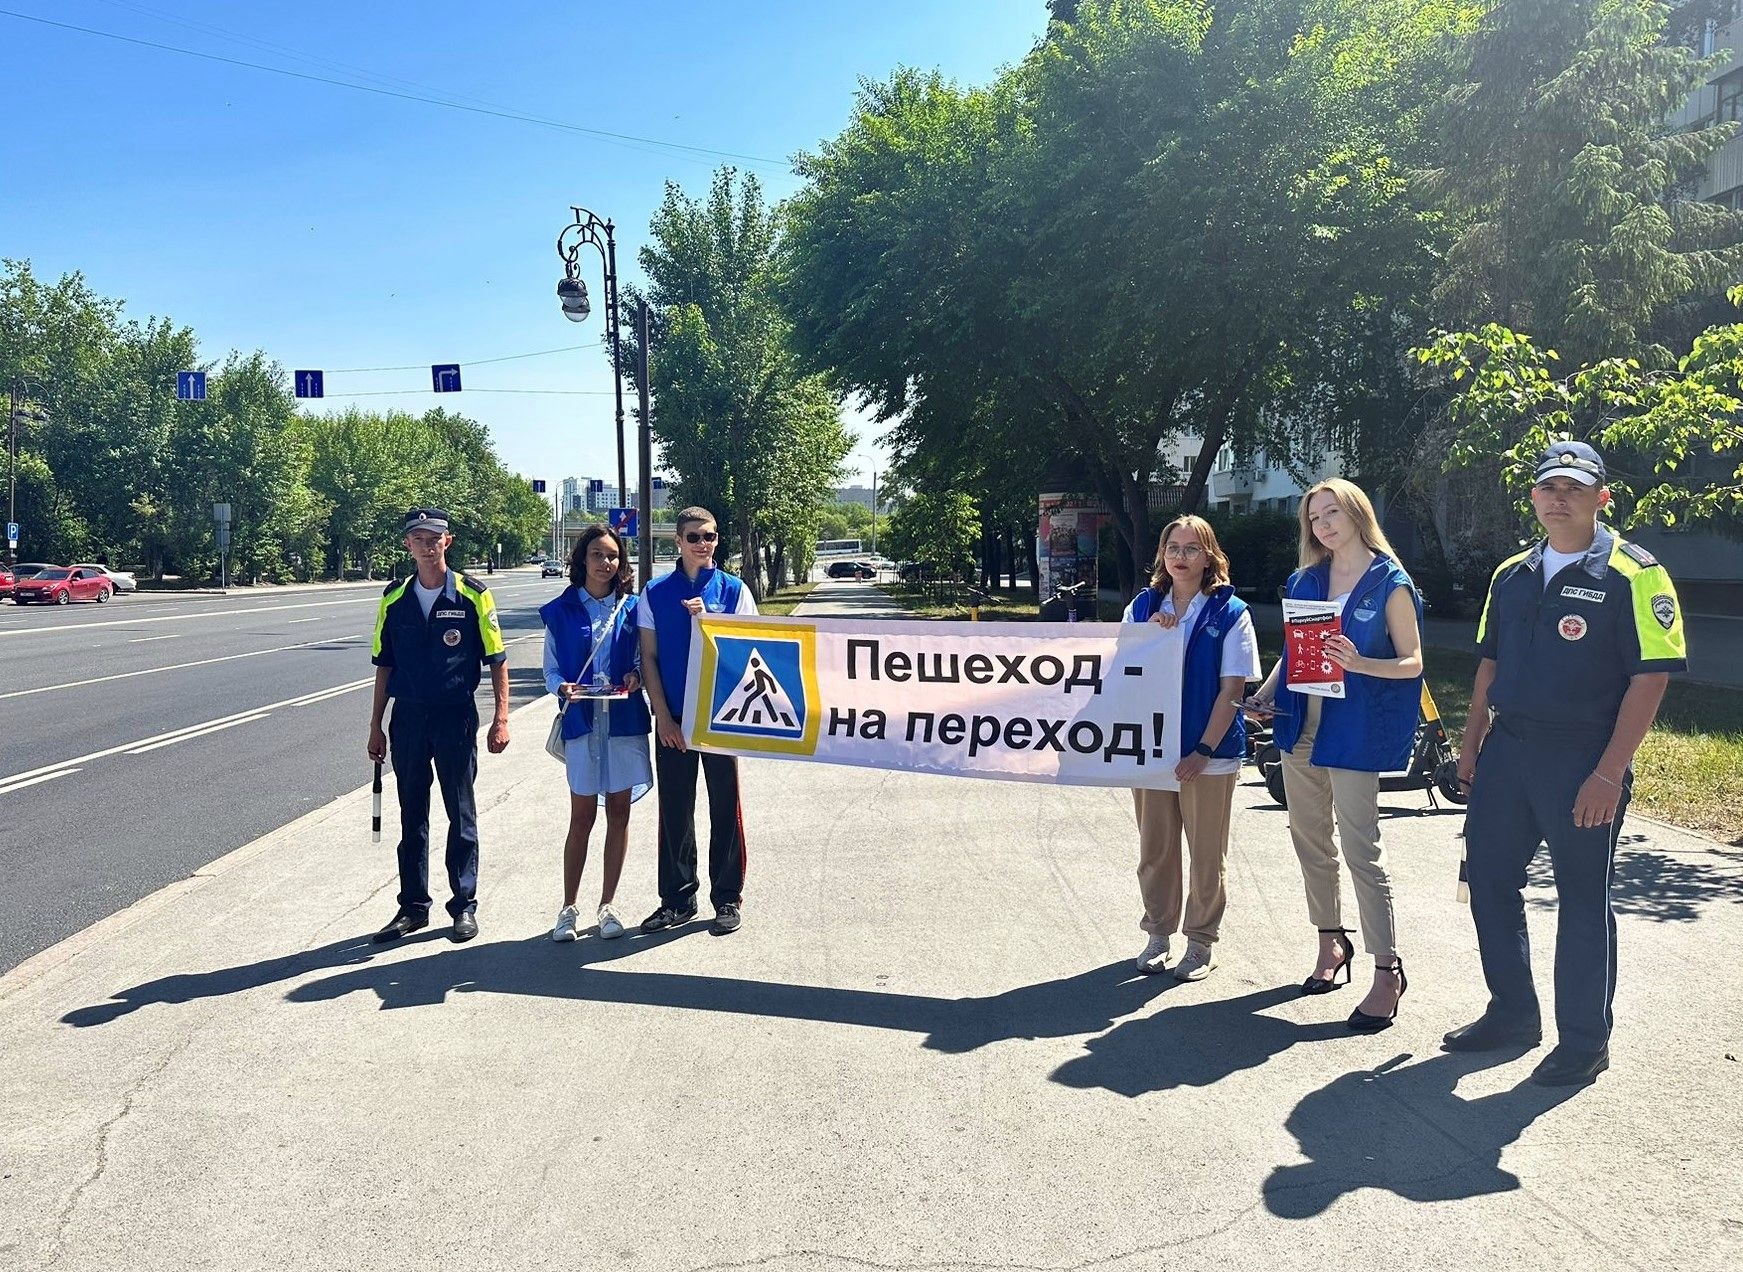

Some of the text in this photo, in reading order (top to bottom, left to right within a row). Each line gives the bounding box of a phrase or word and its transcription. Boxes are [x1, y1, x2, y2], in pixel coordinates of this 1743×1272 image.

[1579, 589, 1604, 600] ГИБДД
[847, 638, 1103, 695] Пешеход
[828, 707, 1164, 766] на переход!
